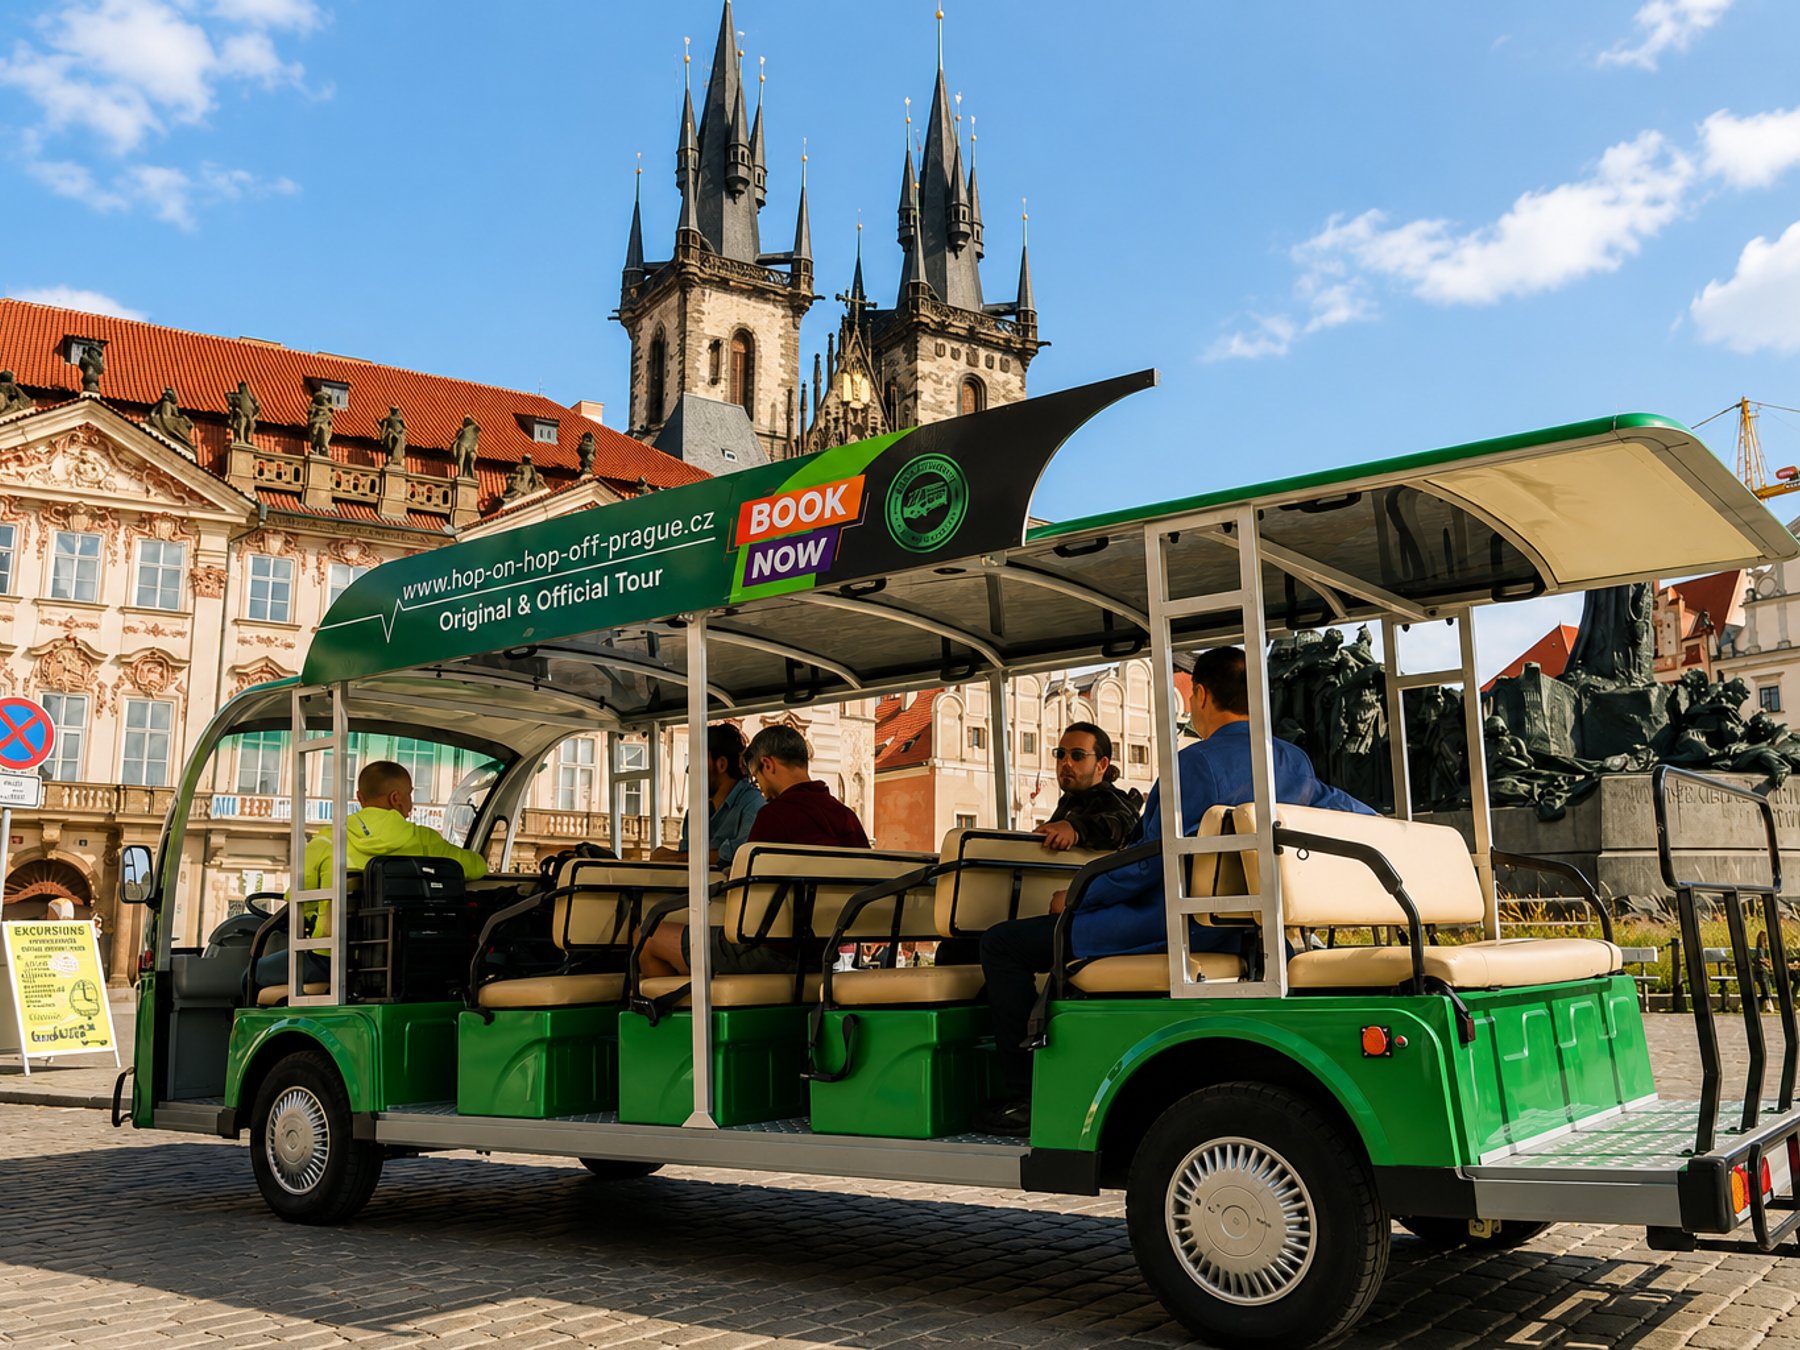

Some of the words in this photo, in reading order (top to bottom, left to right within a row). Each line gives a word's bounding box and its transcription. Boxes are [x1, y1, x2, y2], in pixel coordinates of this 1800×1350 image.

[749, 484, 848, 536] BOOK
[402, 511, 715, 600] www.hop-on-hop-off-prague.cz
[751, 538, 828, 580] NOW
[439, 602, 511, 632] Original
[517, 594, 532, 616] &
[536, 582, 609, 609] Official
[614, 567, 663, 595] Tour
